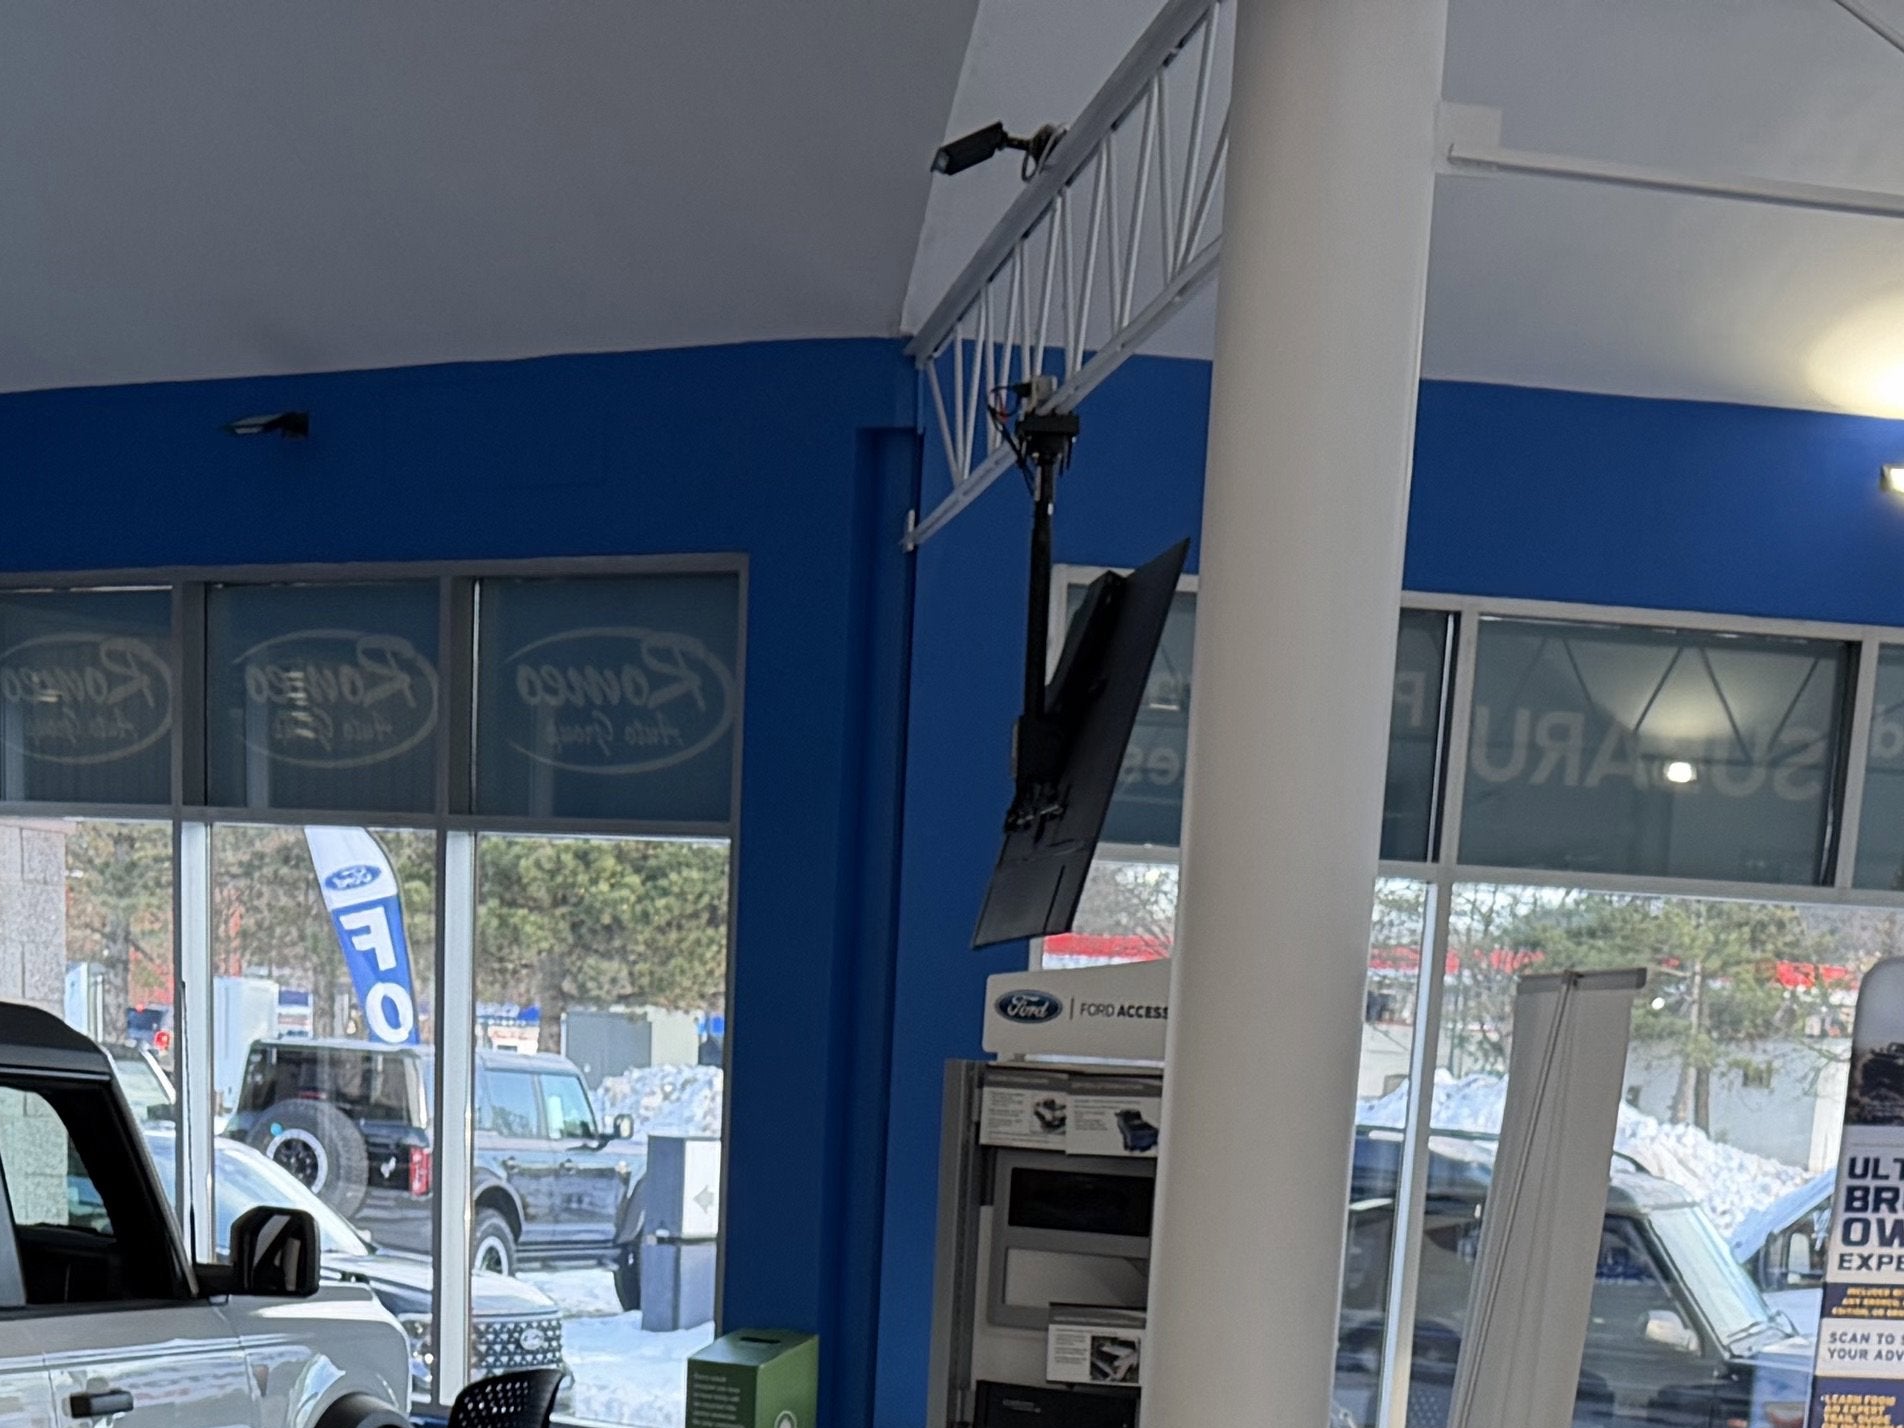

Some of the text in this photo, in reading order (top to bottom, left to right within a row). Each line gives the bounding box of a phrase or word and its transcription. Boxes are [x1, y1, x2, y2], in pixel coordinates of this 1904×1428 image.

[1006, 995, 1049, 1018] Ford
[1080, 1003, 1115, 1017] FORD
[1829, 1332, 1870, 1344] SCAN
[1877, 1333, 1896, 1346] TO
[1828, 1348, 1869, 1361] YOUR
